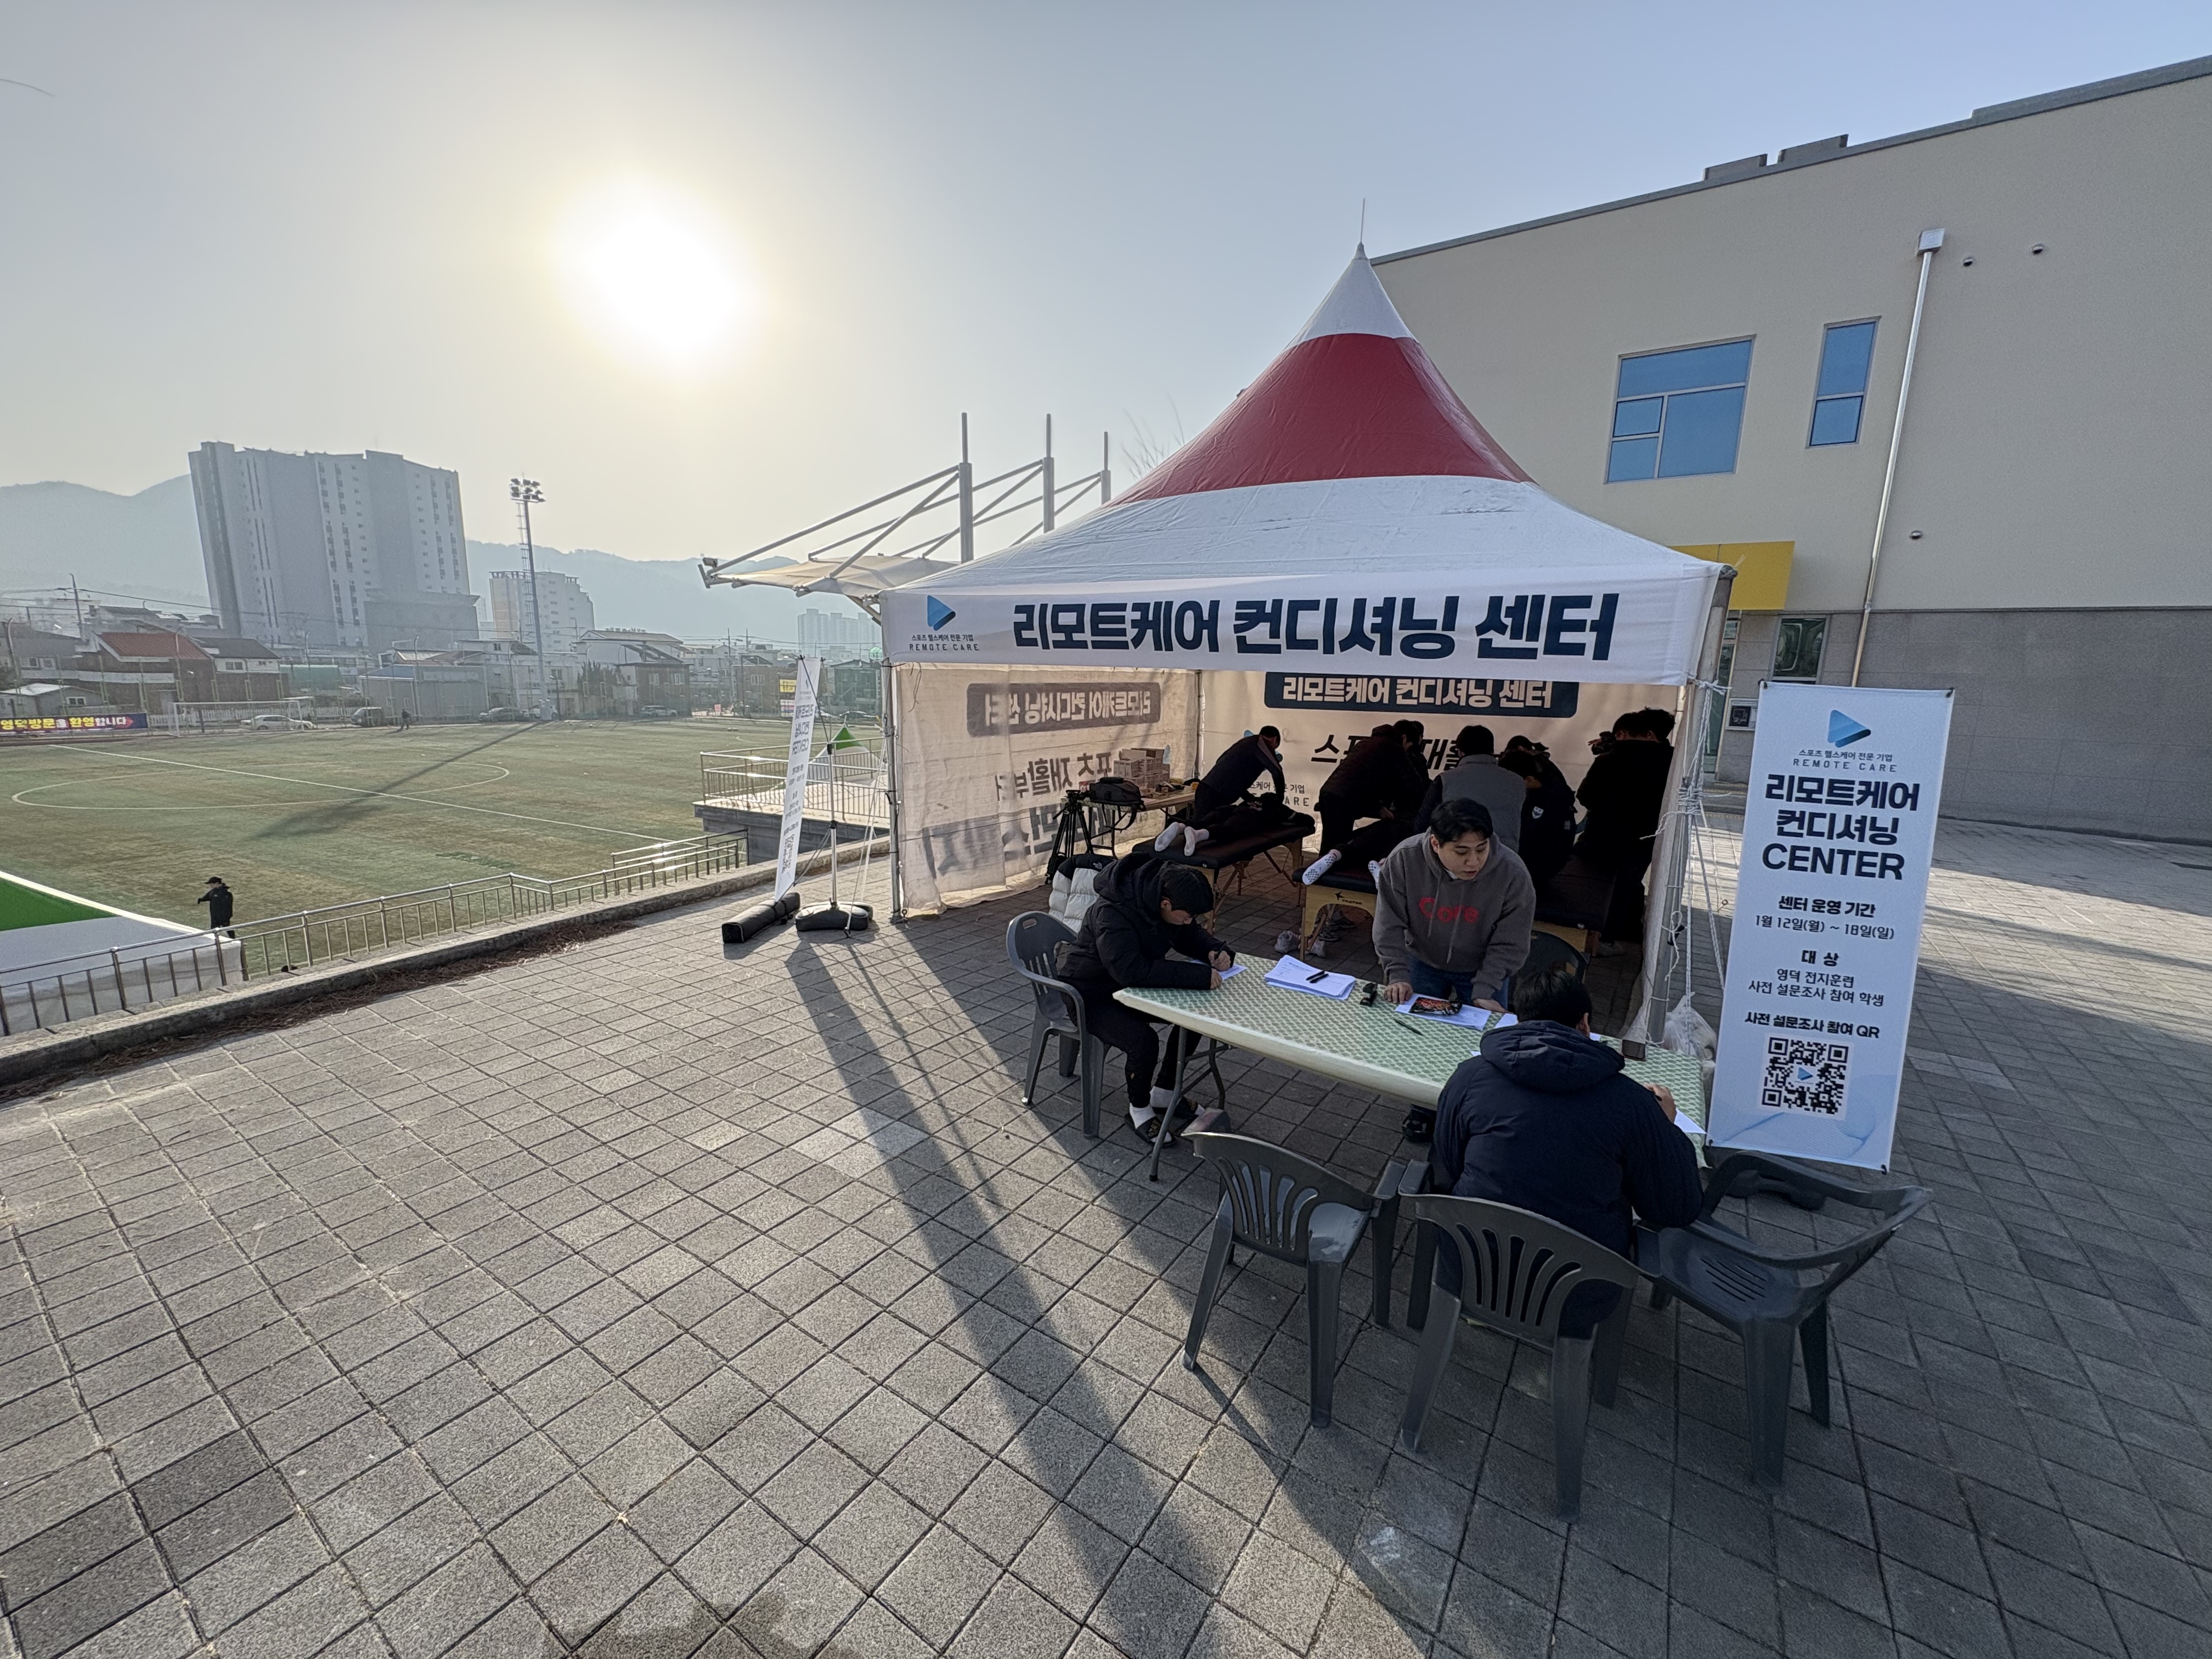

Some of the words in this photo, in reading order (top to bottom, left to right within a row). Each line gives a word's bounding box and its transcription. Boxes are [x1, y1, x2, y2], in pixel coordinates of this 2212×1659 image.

[928, 634, 949, 642] 헬스케어
[962, 634, 974, 642] 기업
[1013, 600, 1221, 653] 리모트케어
[1233, 596, 1459, 659] 컨디셔닝
[1475, 593, 1620, 661] 센터
[1283, 676, 1390, 704] 리모트케어
[1395, 679, 1492, 708] 컨디셔닝
[1498, 681, 1553, 709] 센터
[69, 716, 127, 728] 환영합니다
[1793, 758, 1850, 769] REMOTE
[1859, 763, 1897, 772] CARE
[1825, 750, 1856, 760] 헬스케어
[1858, 752, 1874, 761] 전문
[1876, 753, 1893, 762] 기업
[1290, 784, 1305, 794] 기업
[1765, 774, 1921, 811] 리모트케어
[1284, 795, 1310, 807] ARE
[1776, 809, 1900, 845] 컨디셔닝
[1762, 843, 1905, 880] CENTER
[1779, 895, 1808, 911] 센터
[1811, 899, 1842, 915] 운영
[1844, 902, 1876, 918] 기간
[1756, 915, 1773, 928] 1월
[1777, 917, 1825, 933] 12일(월)
[1844, 924, 1894, 940] 18일(일)
[1801, 950, 1816, 964] 대
[1823, 952, 1839, 967] 상
[1776, 968, 1801, 983] 영덕
[1804, 971, 1854, 989] 전지훈련
[1748, 980, 1773, 994] 사전
[1776, 983, 1826, 1000] 설문조사
[1830, 988, 1854, 1003] 참여
[1859, 992, 1884, 1007] 학생
[1745, 1012, 1770, 1026] 사전
[1773, 1014, 1824, 1032] 설문조사
[1827, 1020, 1853, 1036] 참여
[1856, 1025, 1880, 1039] QR
